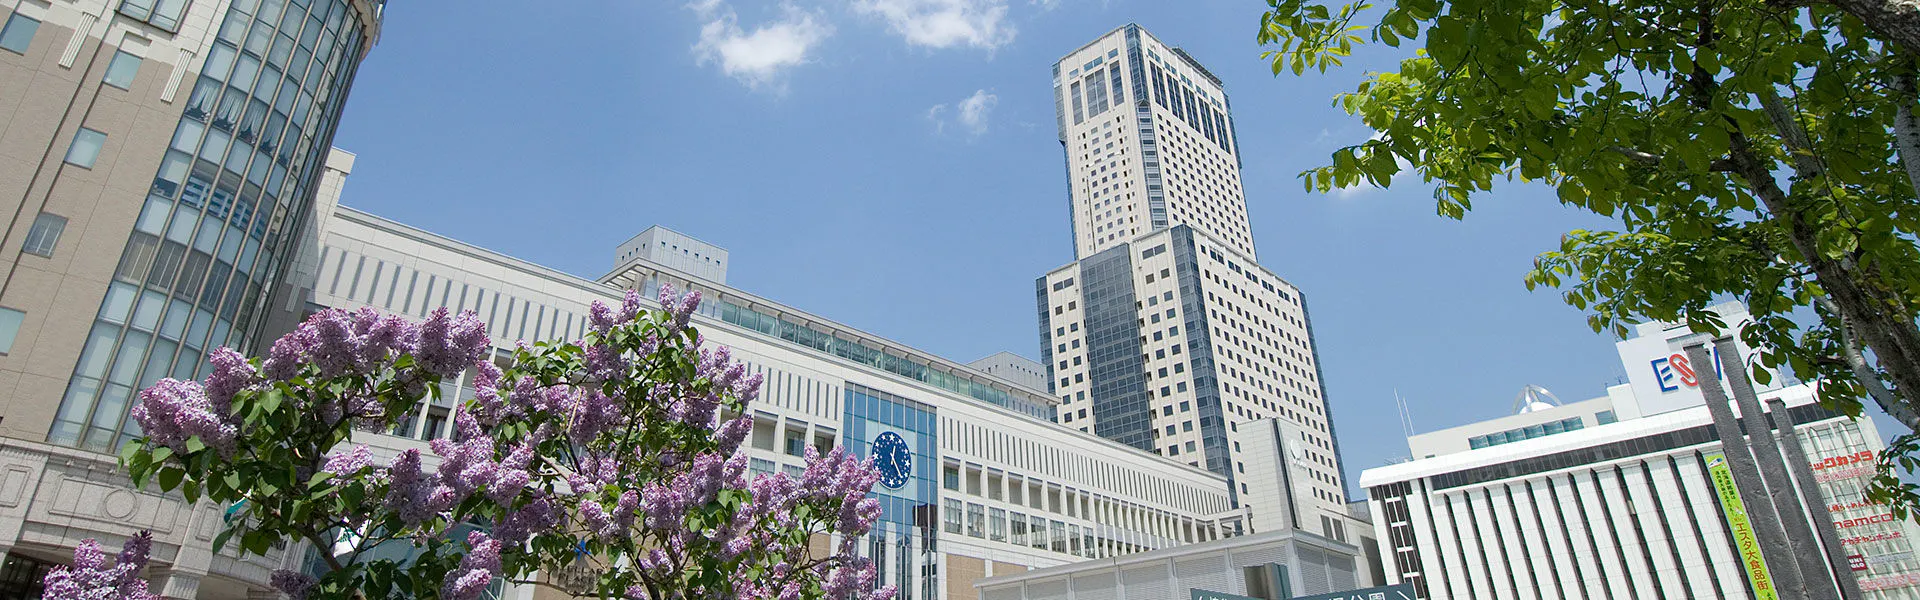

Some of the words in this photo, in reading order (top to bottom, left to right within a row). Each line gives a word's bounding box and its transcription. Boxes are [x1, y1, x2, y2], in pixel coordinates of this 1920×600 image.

[1834, 512, 1893, 529] namco
[1735, 523, 1769, 591] エスタ大食品街
